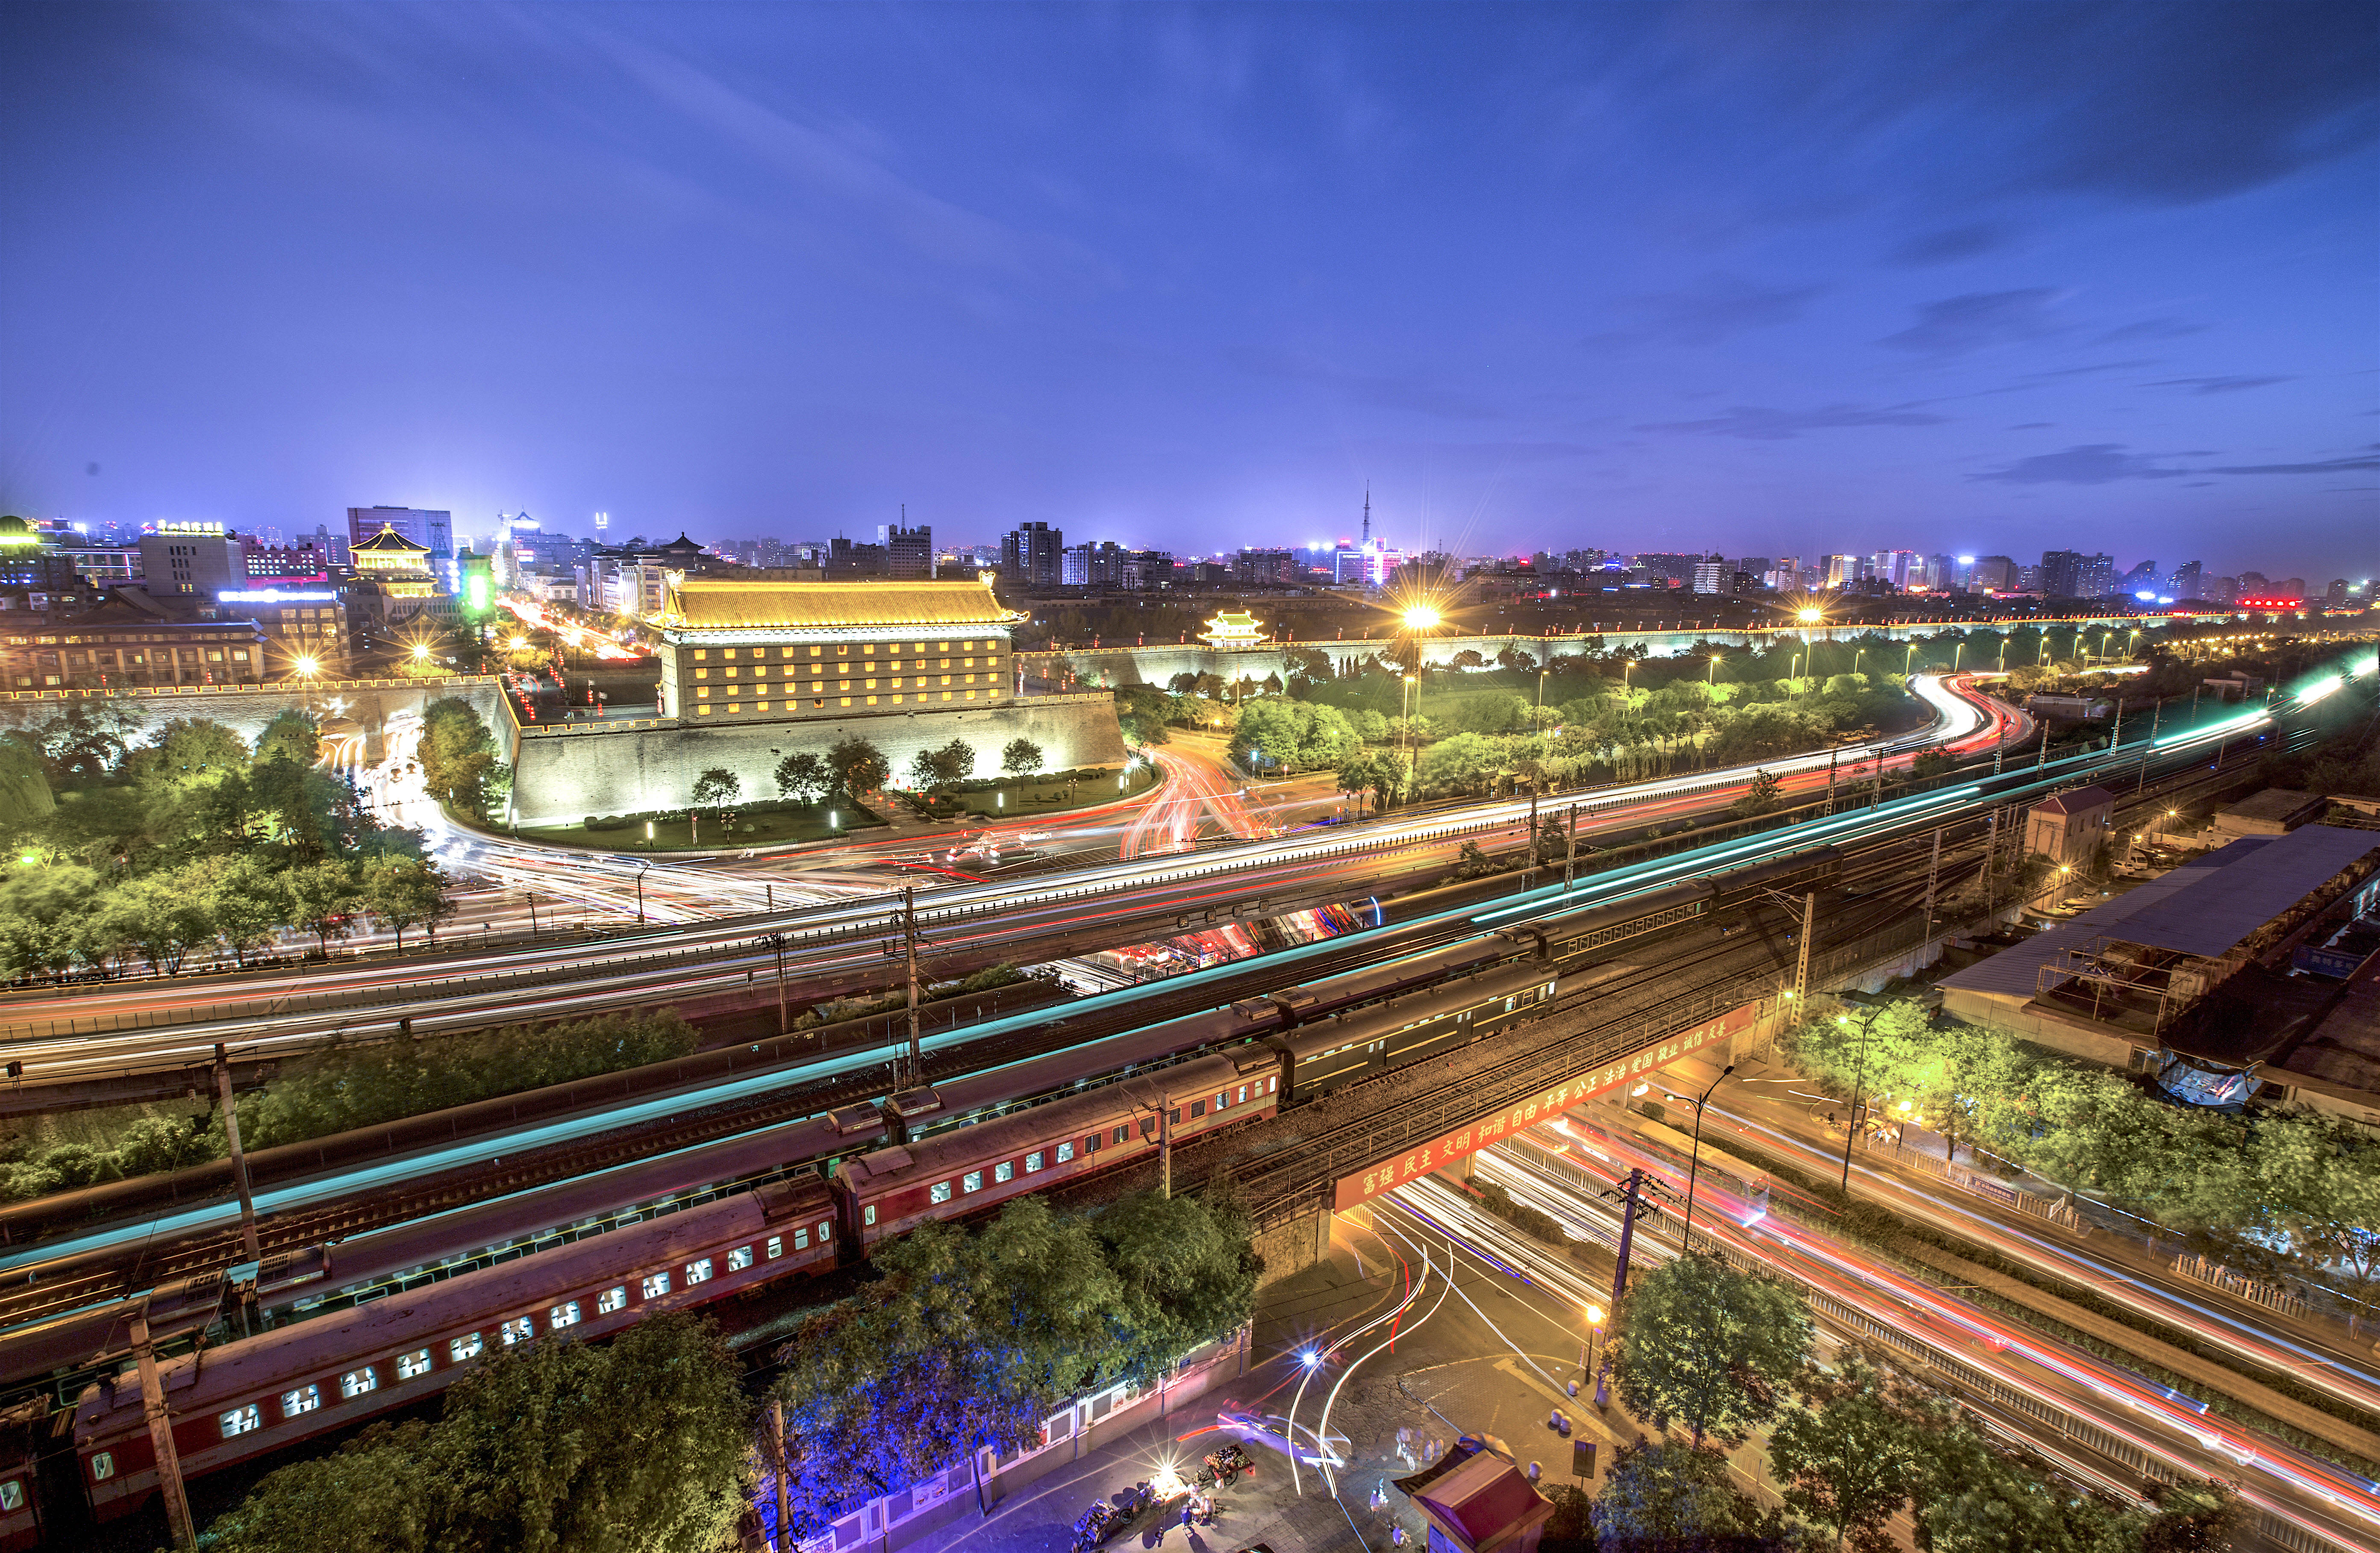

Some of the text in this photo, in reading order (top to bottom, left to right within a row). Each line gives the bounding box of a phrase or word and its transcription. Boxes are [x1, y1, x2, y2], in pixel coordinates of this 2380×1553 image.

[1363, 1165, 1394, 1195] 富强
[1403, 1150, 1432, 1177] 民主
[1441, 1132, 1470, 1159] 文明
[1477, 1116, 1506, 1143] 和谐
[1512, 1103, 1537, 1127] 自由
[1543, 1088, 1568, 1112] 平等
[1574, 1076, 1597, 1100] 公正
[1603, 1064, 1627, 1087] 法治
[1631, 1052, 1653, 1074] 爱国
[1657, 1043, 1678, 1063] 敬业
[1683, 1031, 1703, 1051] 诚信
[1707, 1020, 1726, 1041] 友善
